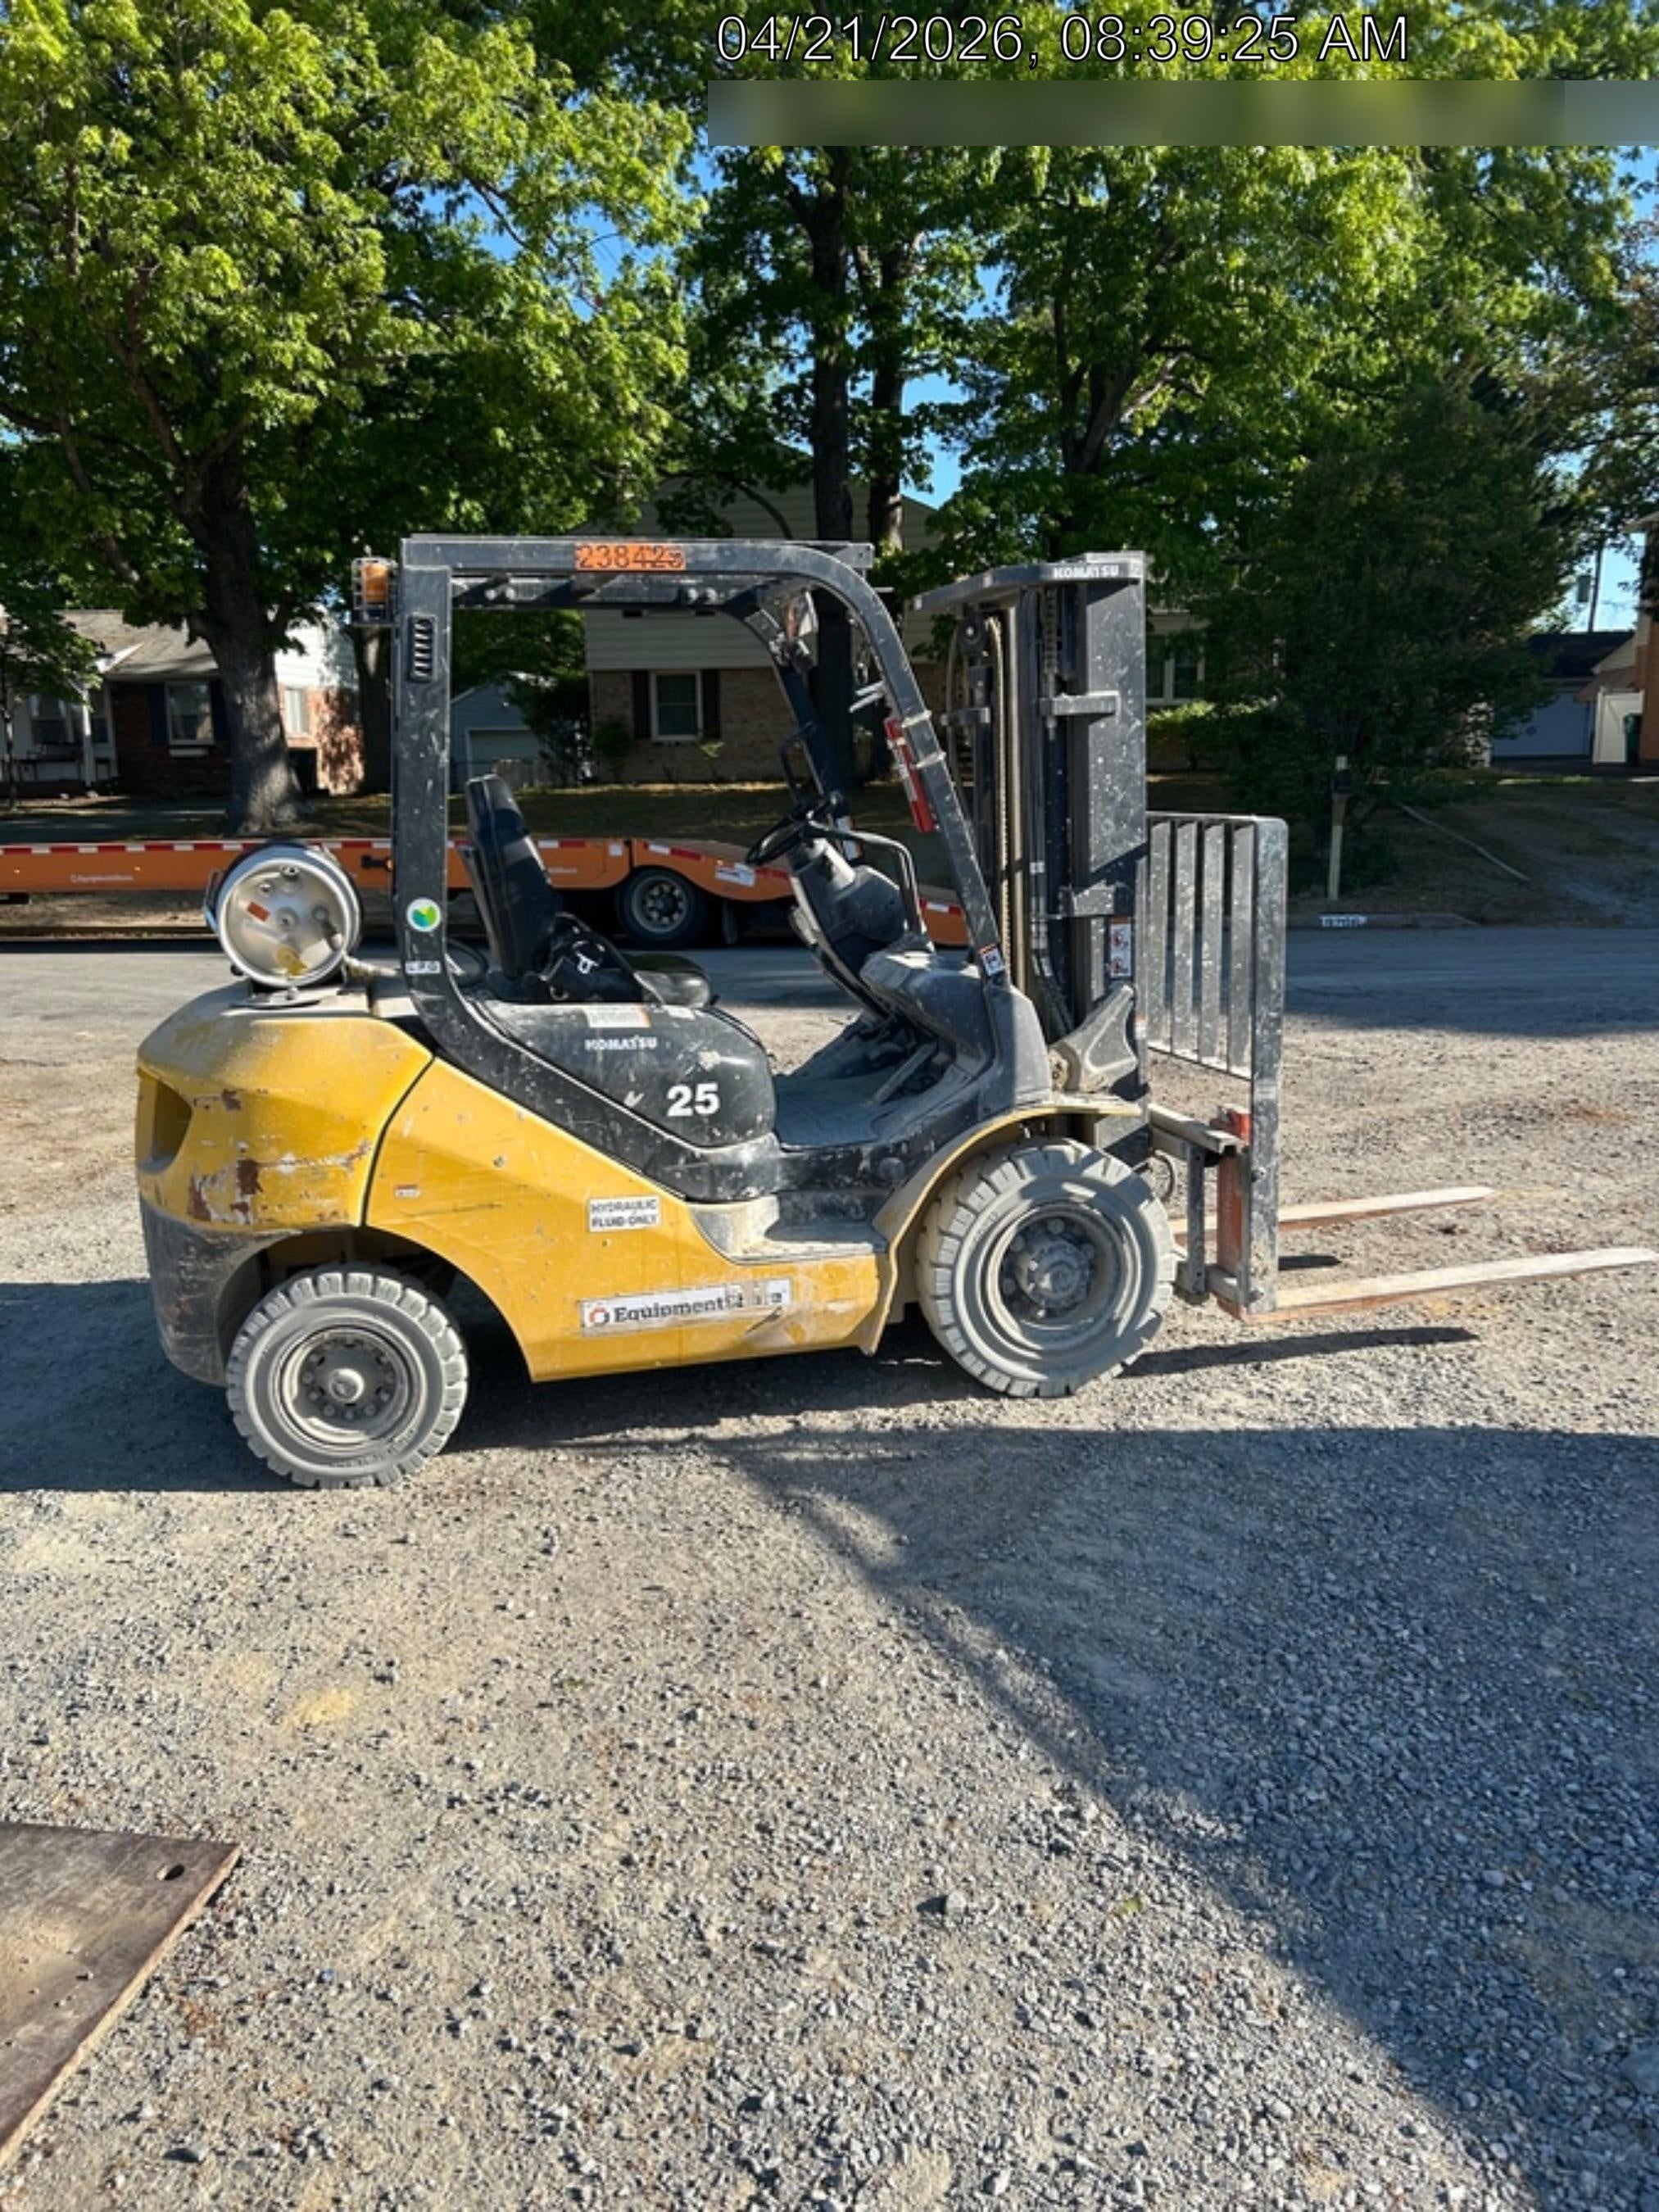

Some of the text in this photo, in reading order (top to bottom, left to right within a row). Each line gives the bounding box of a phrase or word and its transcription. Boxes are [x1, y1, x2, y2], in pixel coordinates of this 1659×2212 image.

[1054, 565, 1119, 578] KOMATSU
[584, 1036, 658, 1050] KOMATSU
[667, 1082, 720, 1117] 25
[592, 1199, 656, 1213] HYDRAULIC
